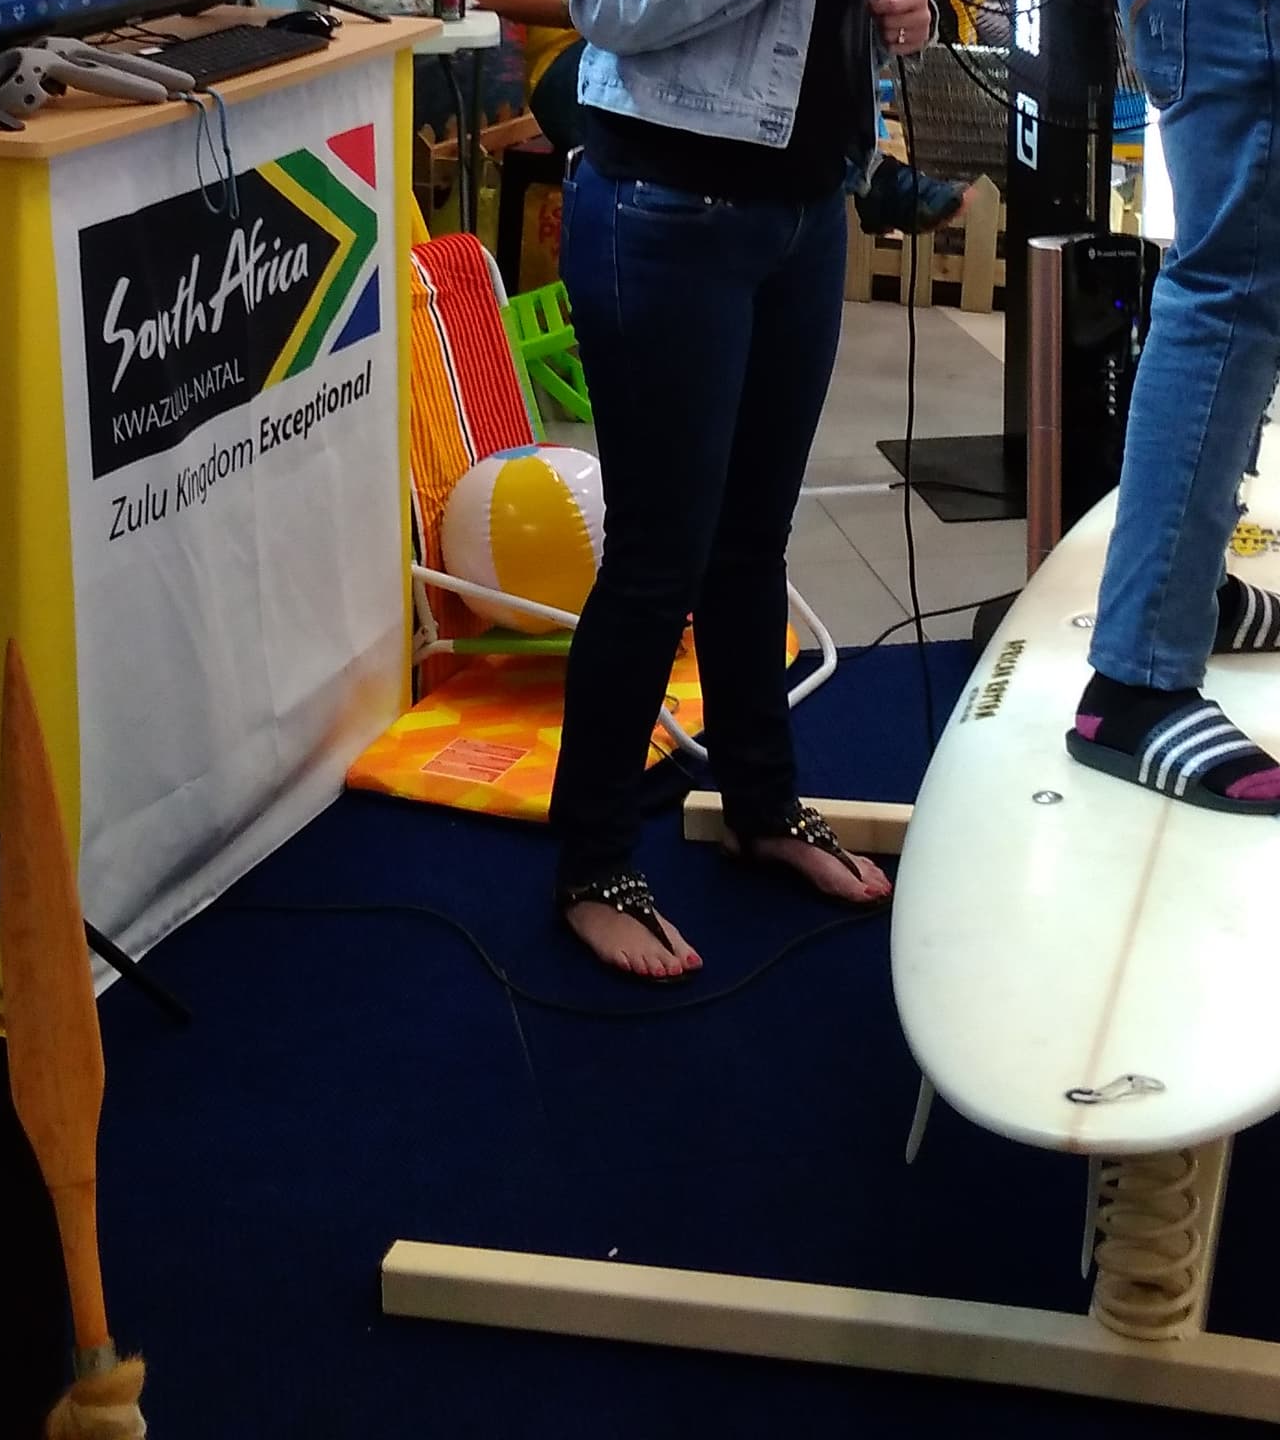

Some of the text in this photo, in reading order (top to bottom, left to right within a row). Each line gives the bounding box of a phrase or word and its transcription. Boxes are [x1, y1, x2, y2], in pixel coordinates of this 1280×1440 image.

[101, 215, 310, 393] South Africa
[108, 360, 372, 542] Zulu Kingdom Exceptional
[111, 356, 245, 444] KWAZULU-NATAL
